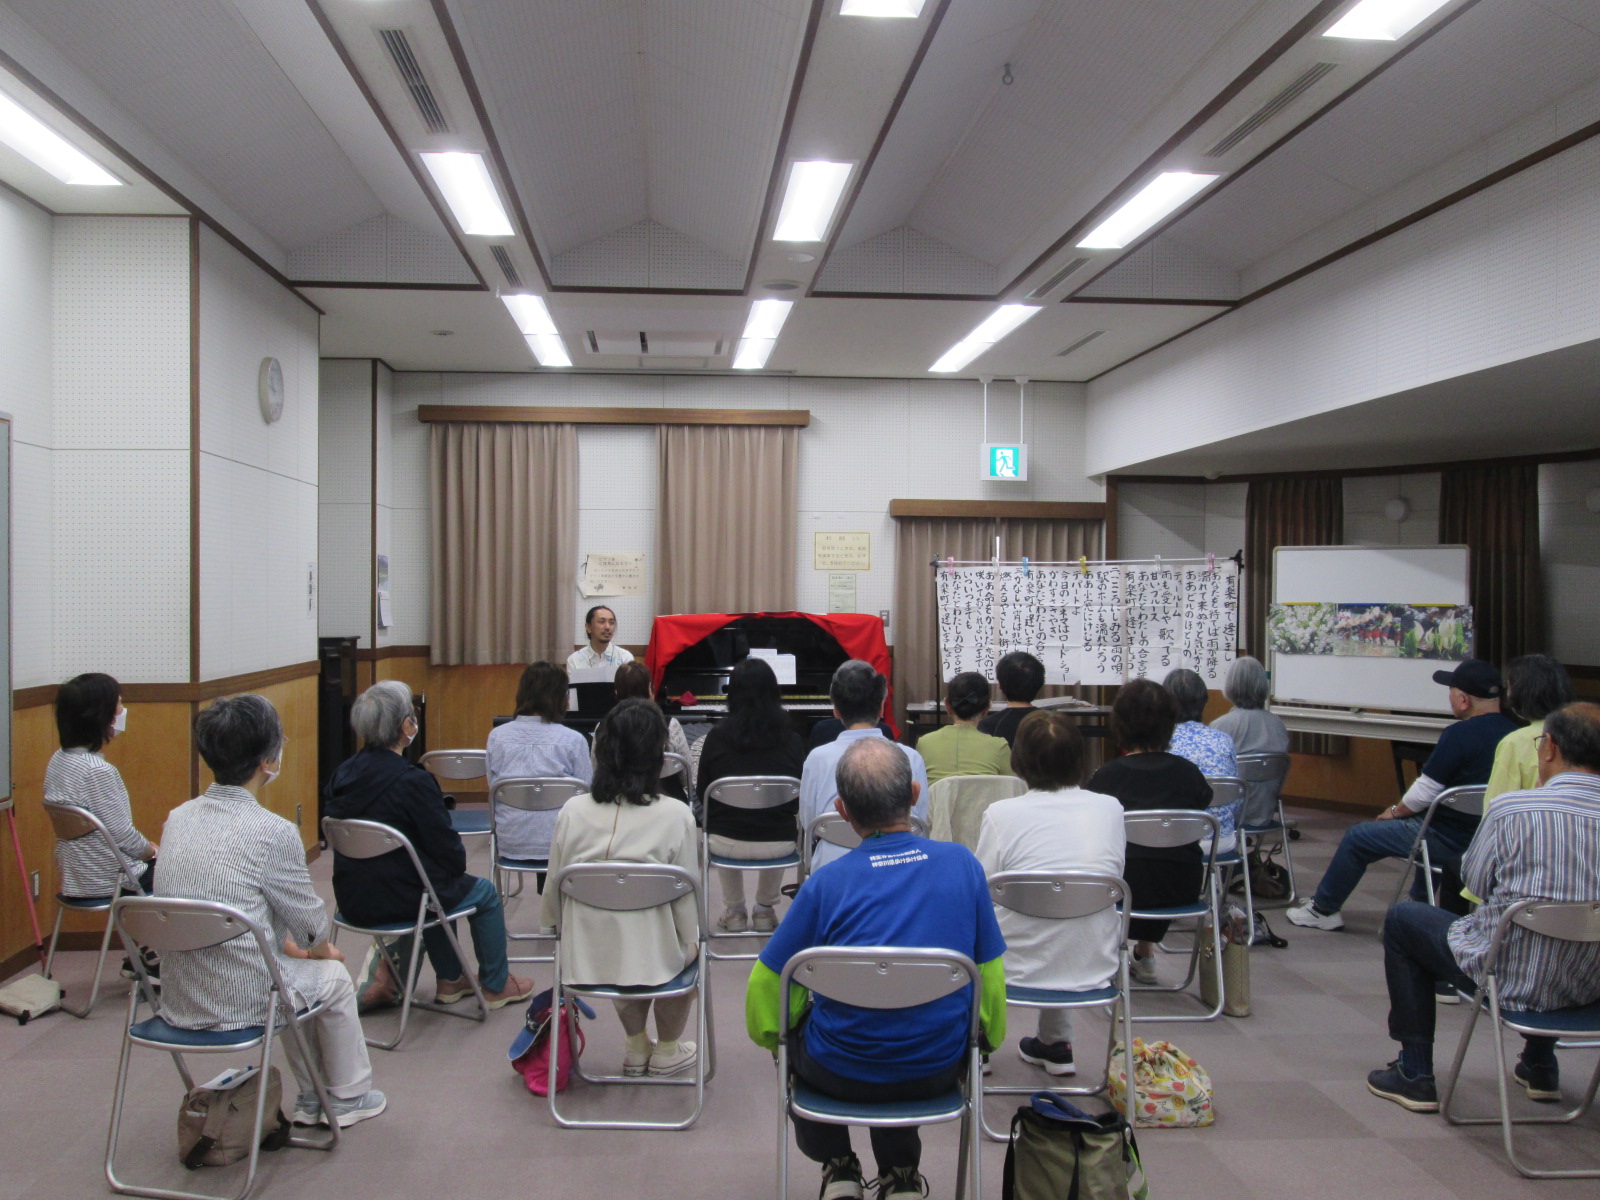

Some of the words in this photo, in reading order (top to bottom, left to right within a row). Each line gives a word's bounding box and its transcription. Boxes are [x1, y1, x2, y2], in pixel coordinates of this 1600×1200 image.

[940, 571, 952, 670] 有楽町で逢いましょう
[963, 572, 974, 630] いついつまでも
[975, 570, 985, 673] 咲いておくれよいつまで
[984, 571, 995, 681] ああ命をかけた恋の花
[1048, 570, 1058, 638] かわすささやき
[1058, 571, 1070, 682] 今日のシネマはロードショー
[1072, 571, 1082, 615] デパートよ
[1096, 571, 1109, 673] 駅のホームも濡れたろう
[1125, 571, 1136, 670] 有楽町で逢いましょう
[1172, 572, 1182, 617] ティールーム
[1183, 570, 1197, 658] ああビルのほとりの
[1194, 572, 1211, 674] 濡れて来ぬかと気にかか
